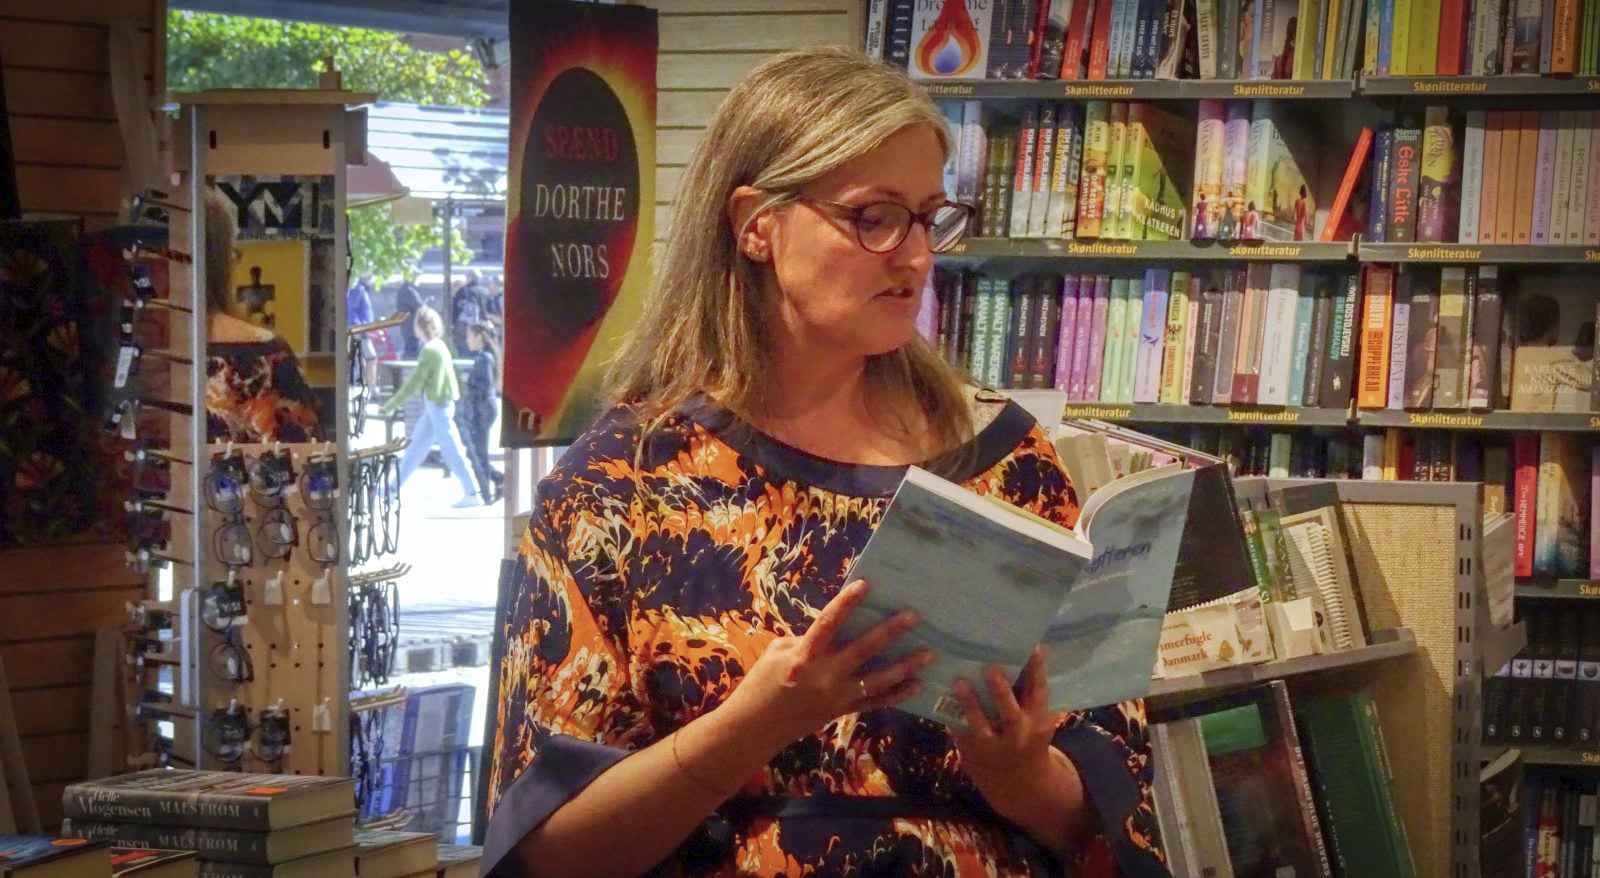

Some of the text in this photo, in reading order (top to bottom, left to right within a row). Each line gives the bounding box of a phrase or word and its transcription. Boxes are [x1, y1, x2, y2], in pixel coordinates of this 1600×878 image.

[1065, 85, 1134, 96] Skønlitteratur
[1233, 85, 1304, 96] Skønlitteratur
[1413, 81, 1487, 92] Skønlitteratur
[1027, 129, 1035, 143] KIM
[1063, 129, 1072, 143] KIM
[546, 125, 617, 162] SPÆND
[535, 184, 626, 222] DORTHE
[1068, 243, 1138, 254] Skønlitteratur
[1408, 247, 1481, 259] Skønlitteratur
[551, 244, 610, 280] NORS
[1340, 303, 1355, 357] DOSTOJEVSKIJ
[1330, 314, 1342, 361] KARAMAZOV
[1392, 323, 1406, 384] FISKERNE
[1364, 340, 1382, 392] COPPERHEAD
[1523, 364, 1575, 375] KARL OVE
[1410, 414, 1484, 426] Skønlitteratur
[92, 789, 121, 803] Helle
[79, 794, 152, 818] Mogensen
